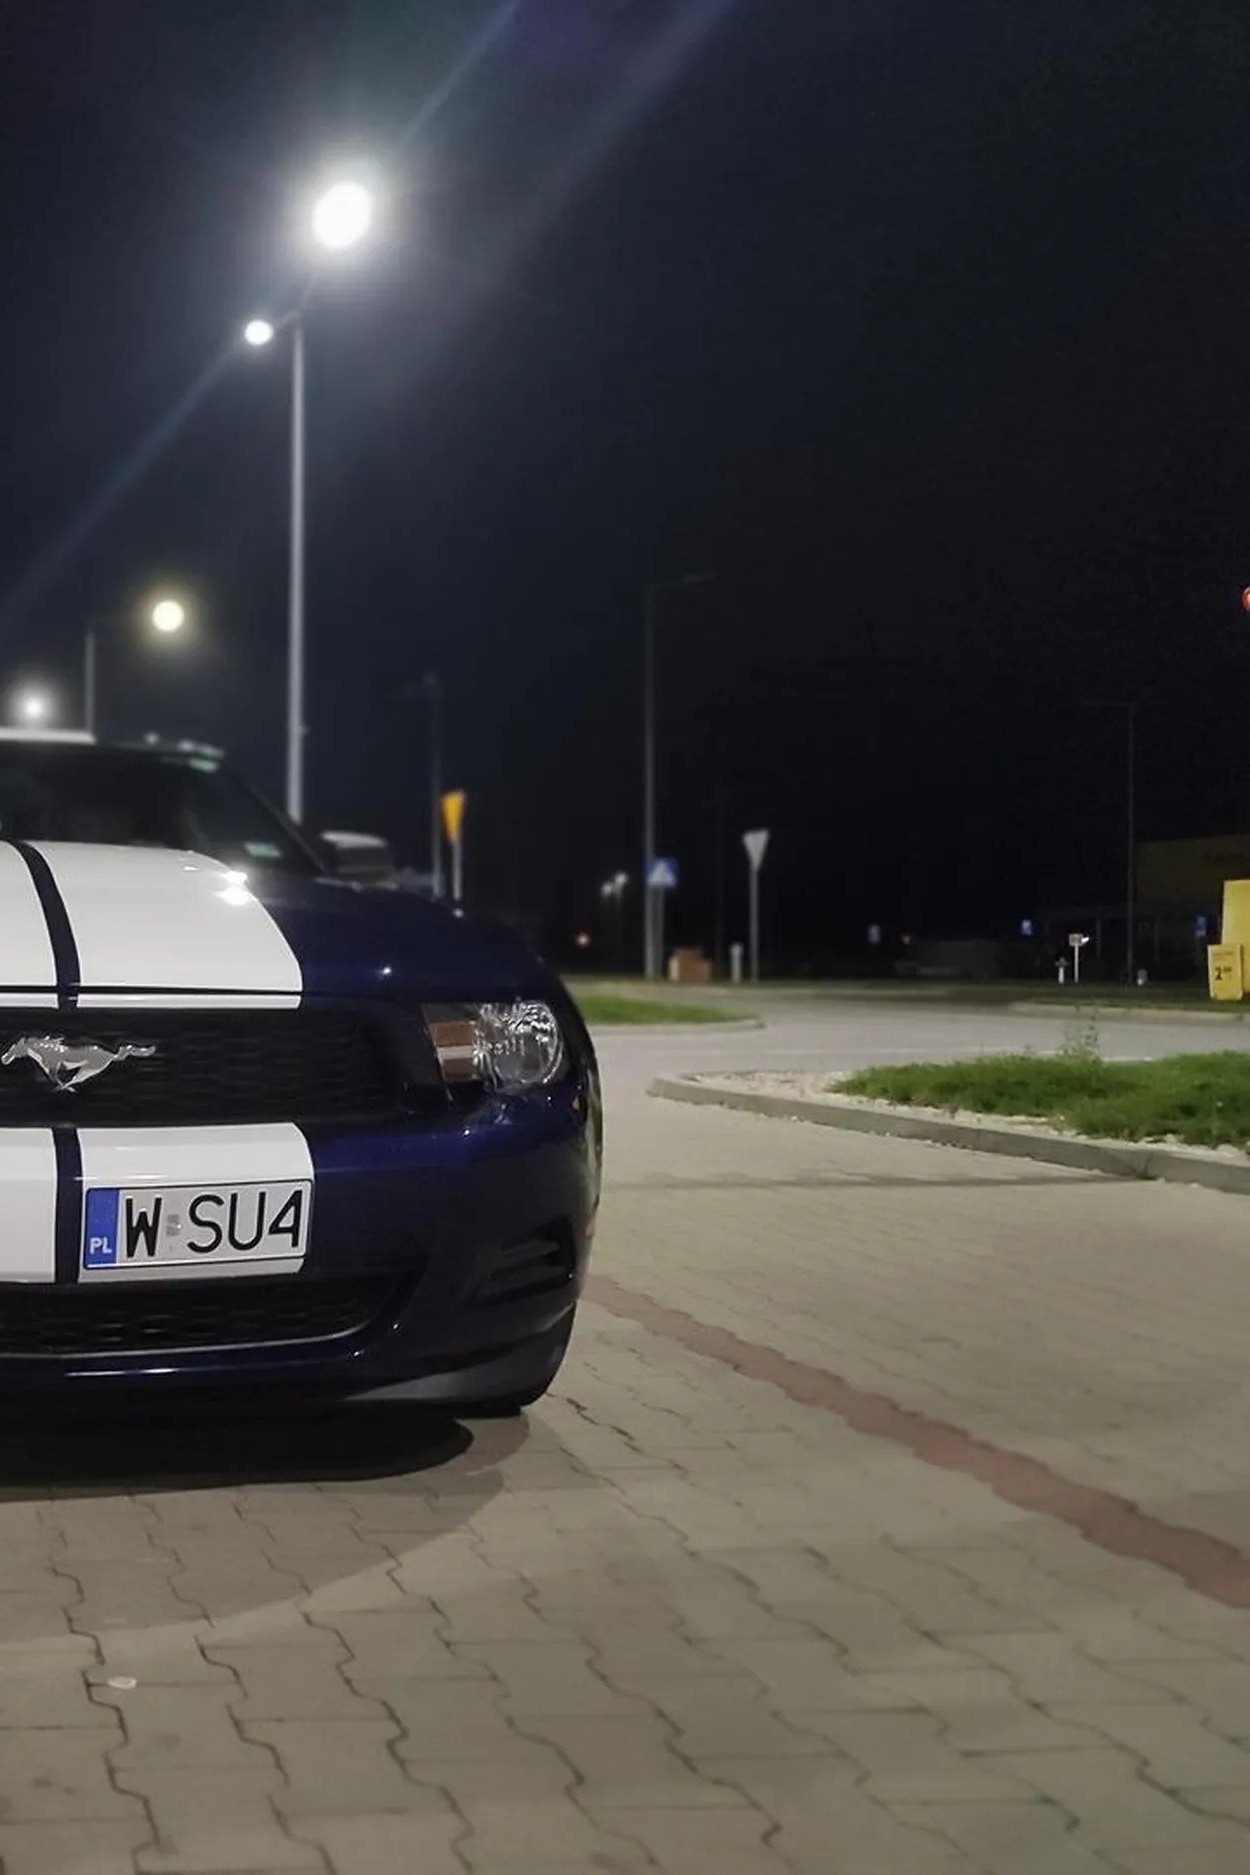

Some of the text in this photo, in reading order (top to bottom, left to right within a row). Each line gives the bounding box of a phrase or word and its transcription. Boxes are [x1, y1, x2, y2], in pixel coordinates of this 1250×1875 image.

[89, 1236, 113, 1255] PL
[126, 1189, 303, 1258] W SU4
